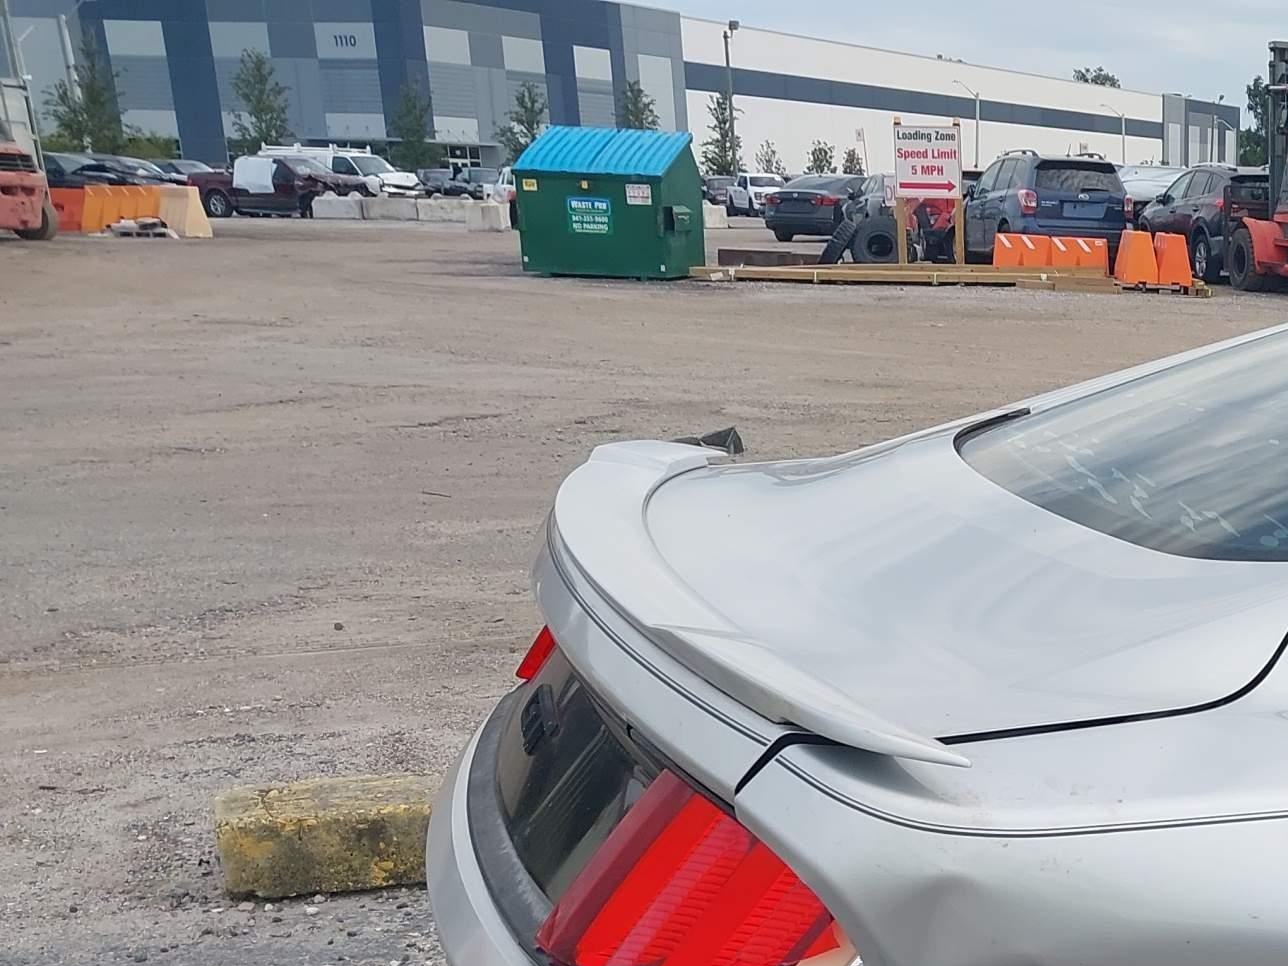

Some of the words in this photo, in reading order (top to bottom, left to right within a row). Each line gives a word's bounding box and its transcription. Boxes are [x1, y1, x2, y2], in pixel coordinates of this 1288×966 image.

[333, 35, 357, 47] 1110
[897, 130, 932, 143] Loading
[935, 130, 956, 141] Zone
[897, 148, 928, 160] Speed
[931, 149, 957, 160] Limit
[911, 165, 917, 175] 5
[921, 165, 944, 176] MPH
